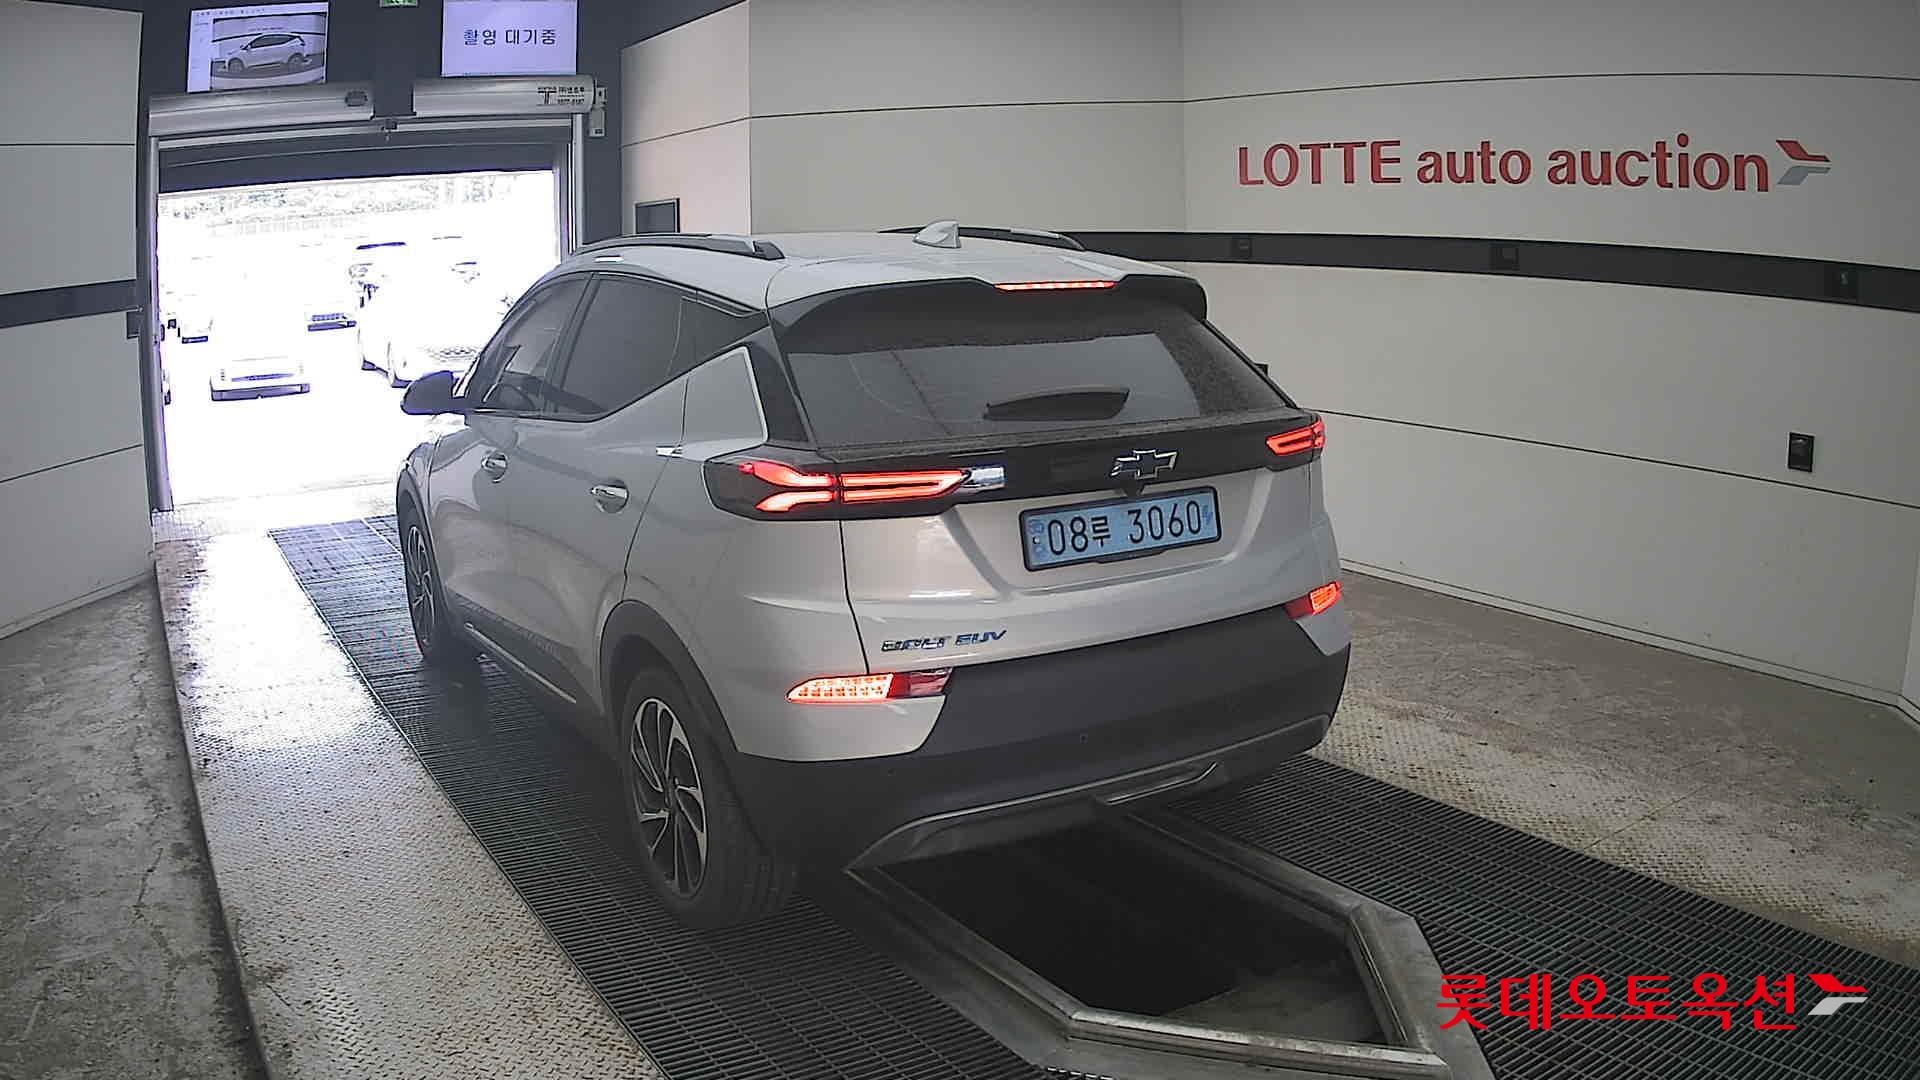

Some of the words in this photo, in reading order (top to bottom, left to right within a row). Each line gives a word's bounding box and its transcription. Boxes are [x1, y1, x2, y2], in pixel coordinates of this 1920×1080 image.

[464, 29, 497, 46] 촬영
[504, 29, 557, 46] 대기중
[1239, 139, 1401, 187] LOTTE
[1416, 140, 1532, 185] auto
[1547, 132, 1769, 193] auction
[1047, 515, 1111, 556] 08루
[1127, 500, 1202, 544] 3060
[955, 629, 1007, 646] EUV
